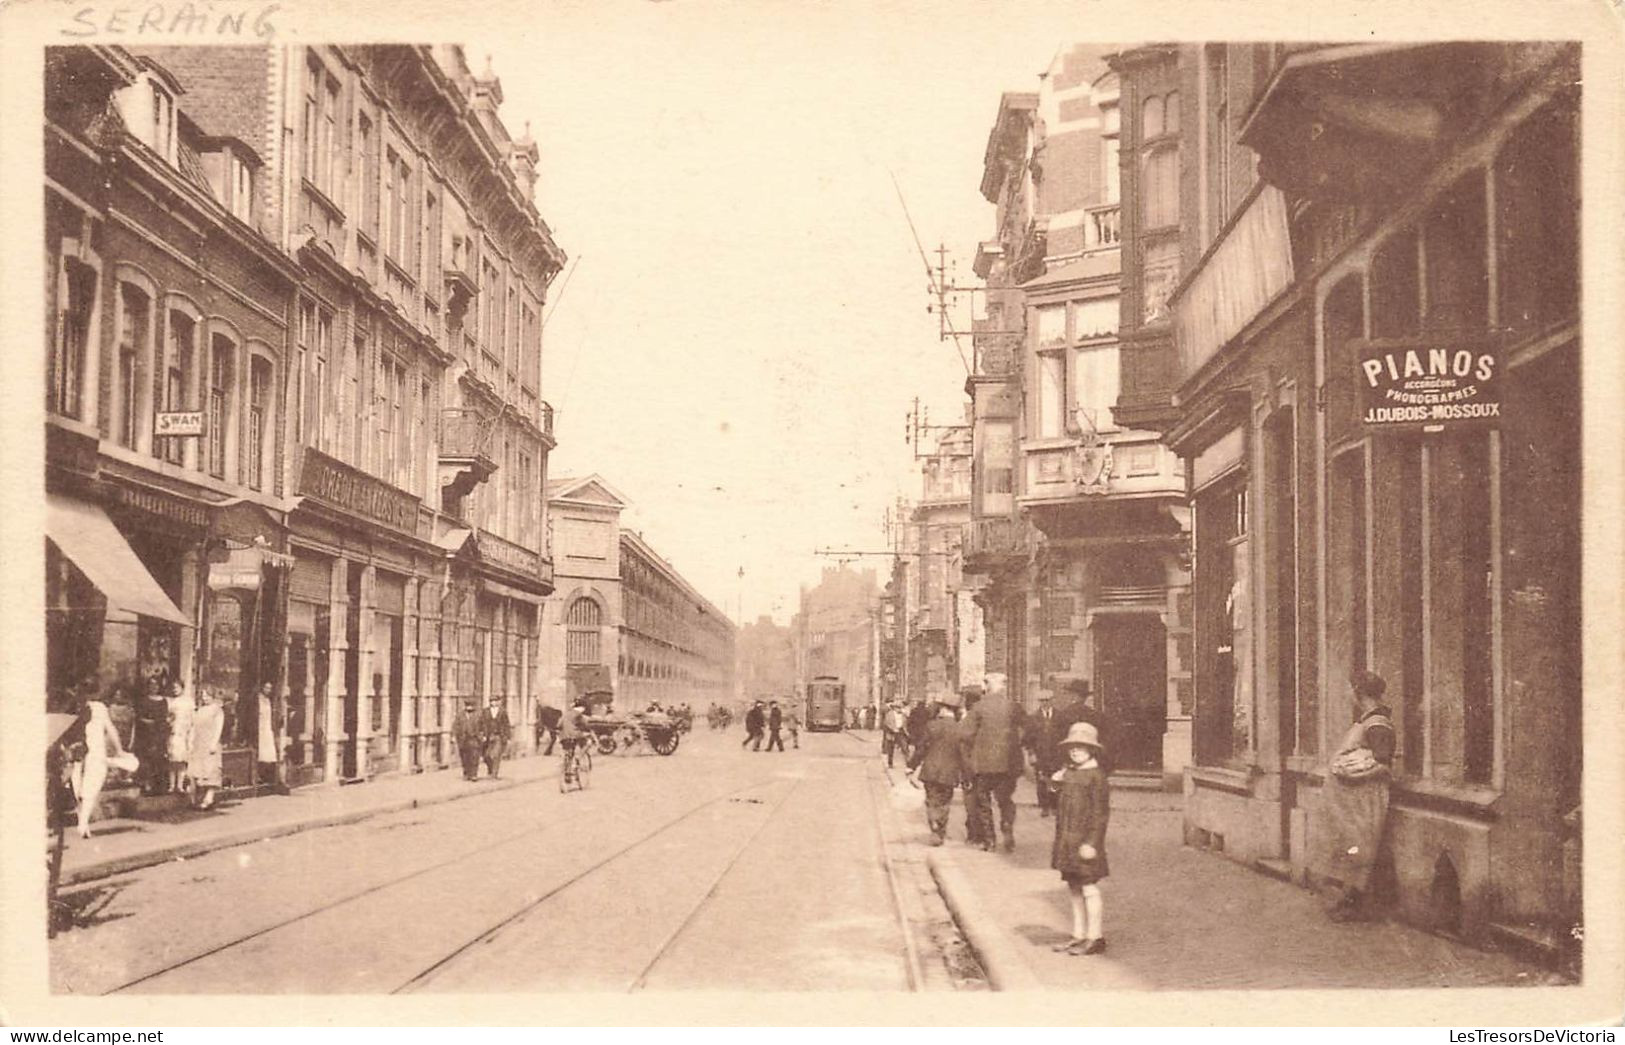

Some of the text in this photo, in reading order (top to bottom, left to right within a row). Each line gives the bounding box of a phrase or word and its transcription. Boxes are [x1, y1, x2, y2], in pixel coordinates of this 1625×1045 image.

[1362, 349, 1495, 388] PIANOS
[1386, 385, 1478, 404] PHONOGRAPHES
[159, 414, 199, 429] SWAN
[1365, 404, 1500, 421] J.DUBOIS-MOSSOUX
